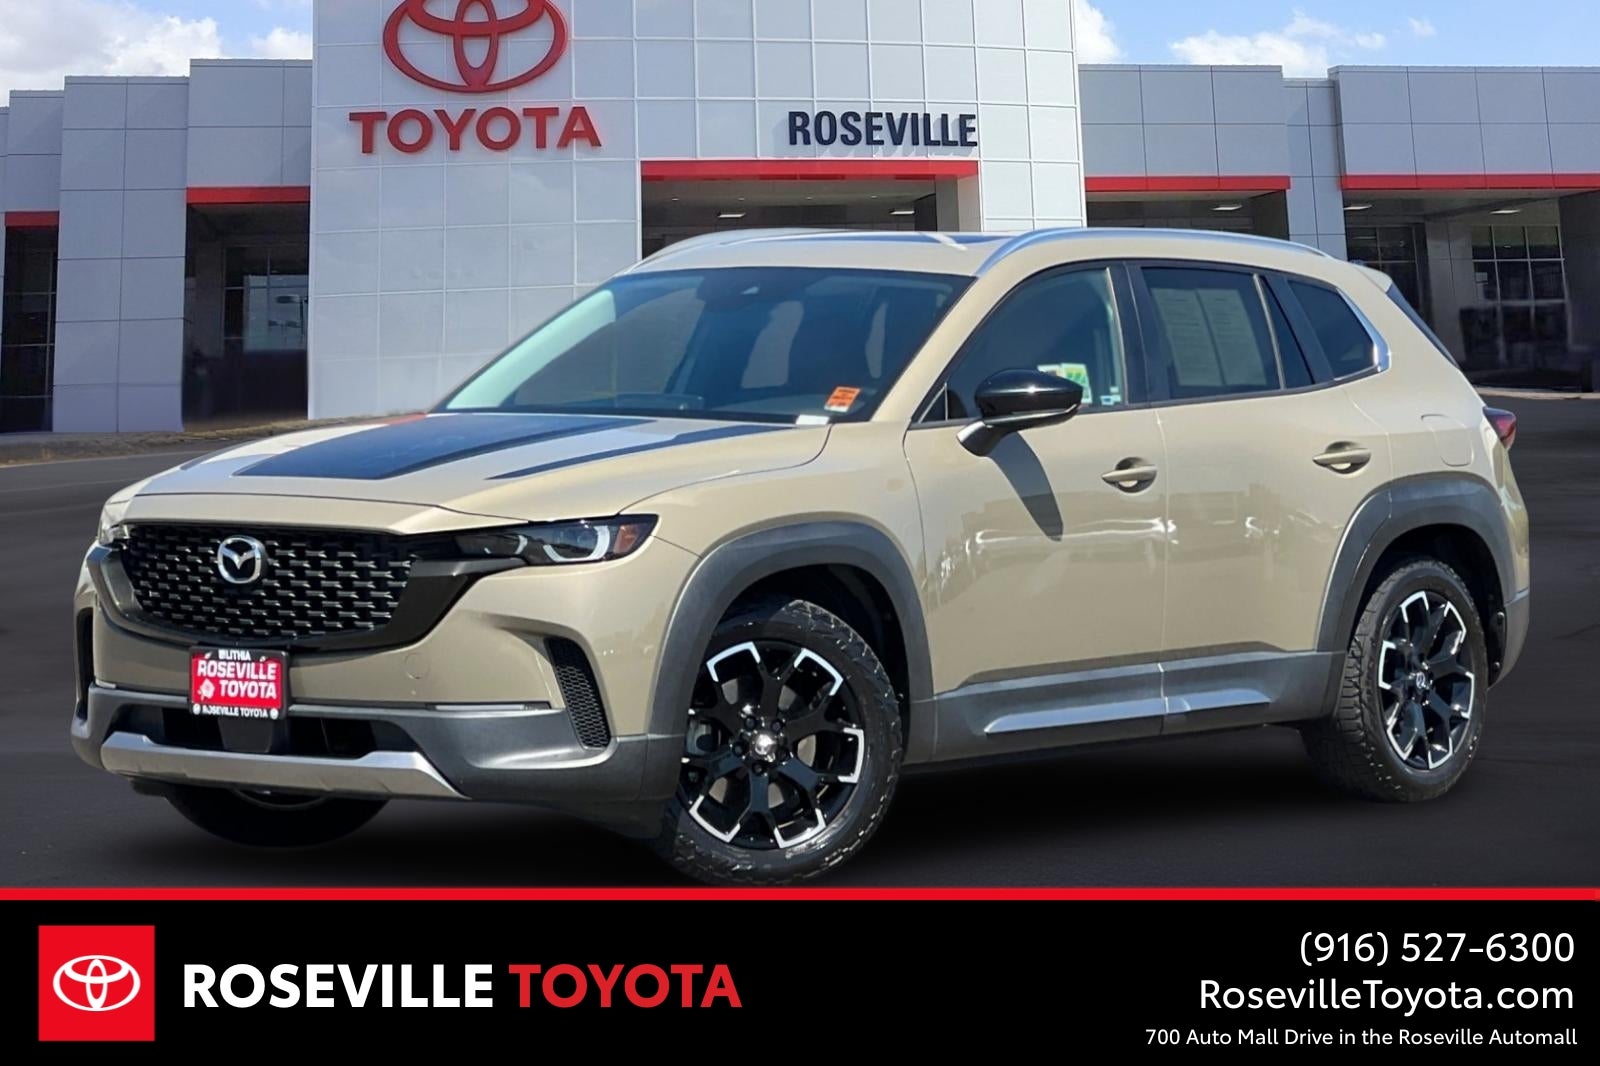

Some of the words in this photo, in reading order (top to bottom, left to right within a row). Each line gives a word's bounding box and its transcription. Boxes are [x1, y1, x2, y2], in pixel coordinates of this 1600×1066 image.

[349, 106, 602, 154] TOYOTA
[788, 110, 978, 147] ROSEVILLE
[197, 660, 278, 680] ROSEVILLE
[219, 680, 277, 699] TOYOTA
[202, 705, 239, 716] ROSEVILLE
[240, 707, 268, 718] TOYOTA
